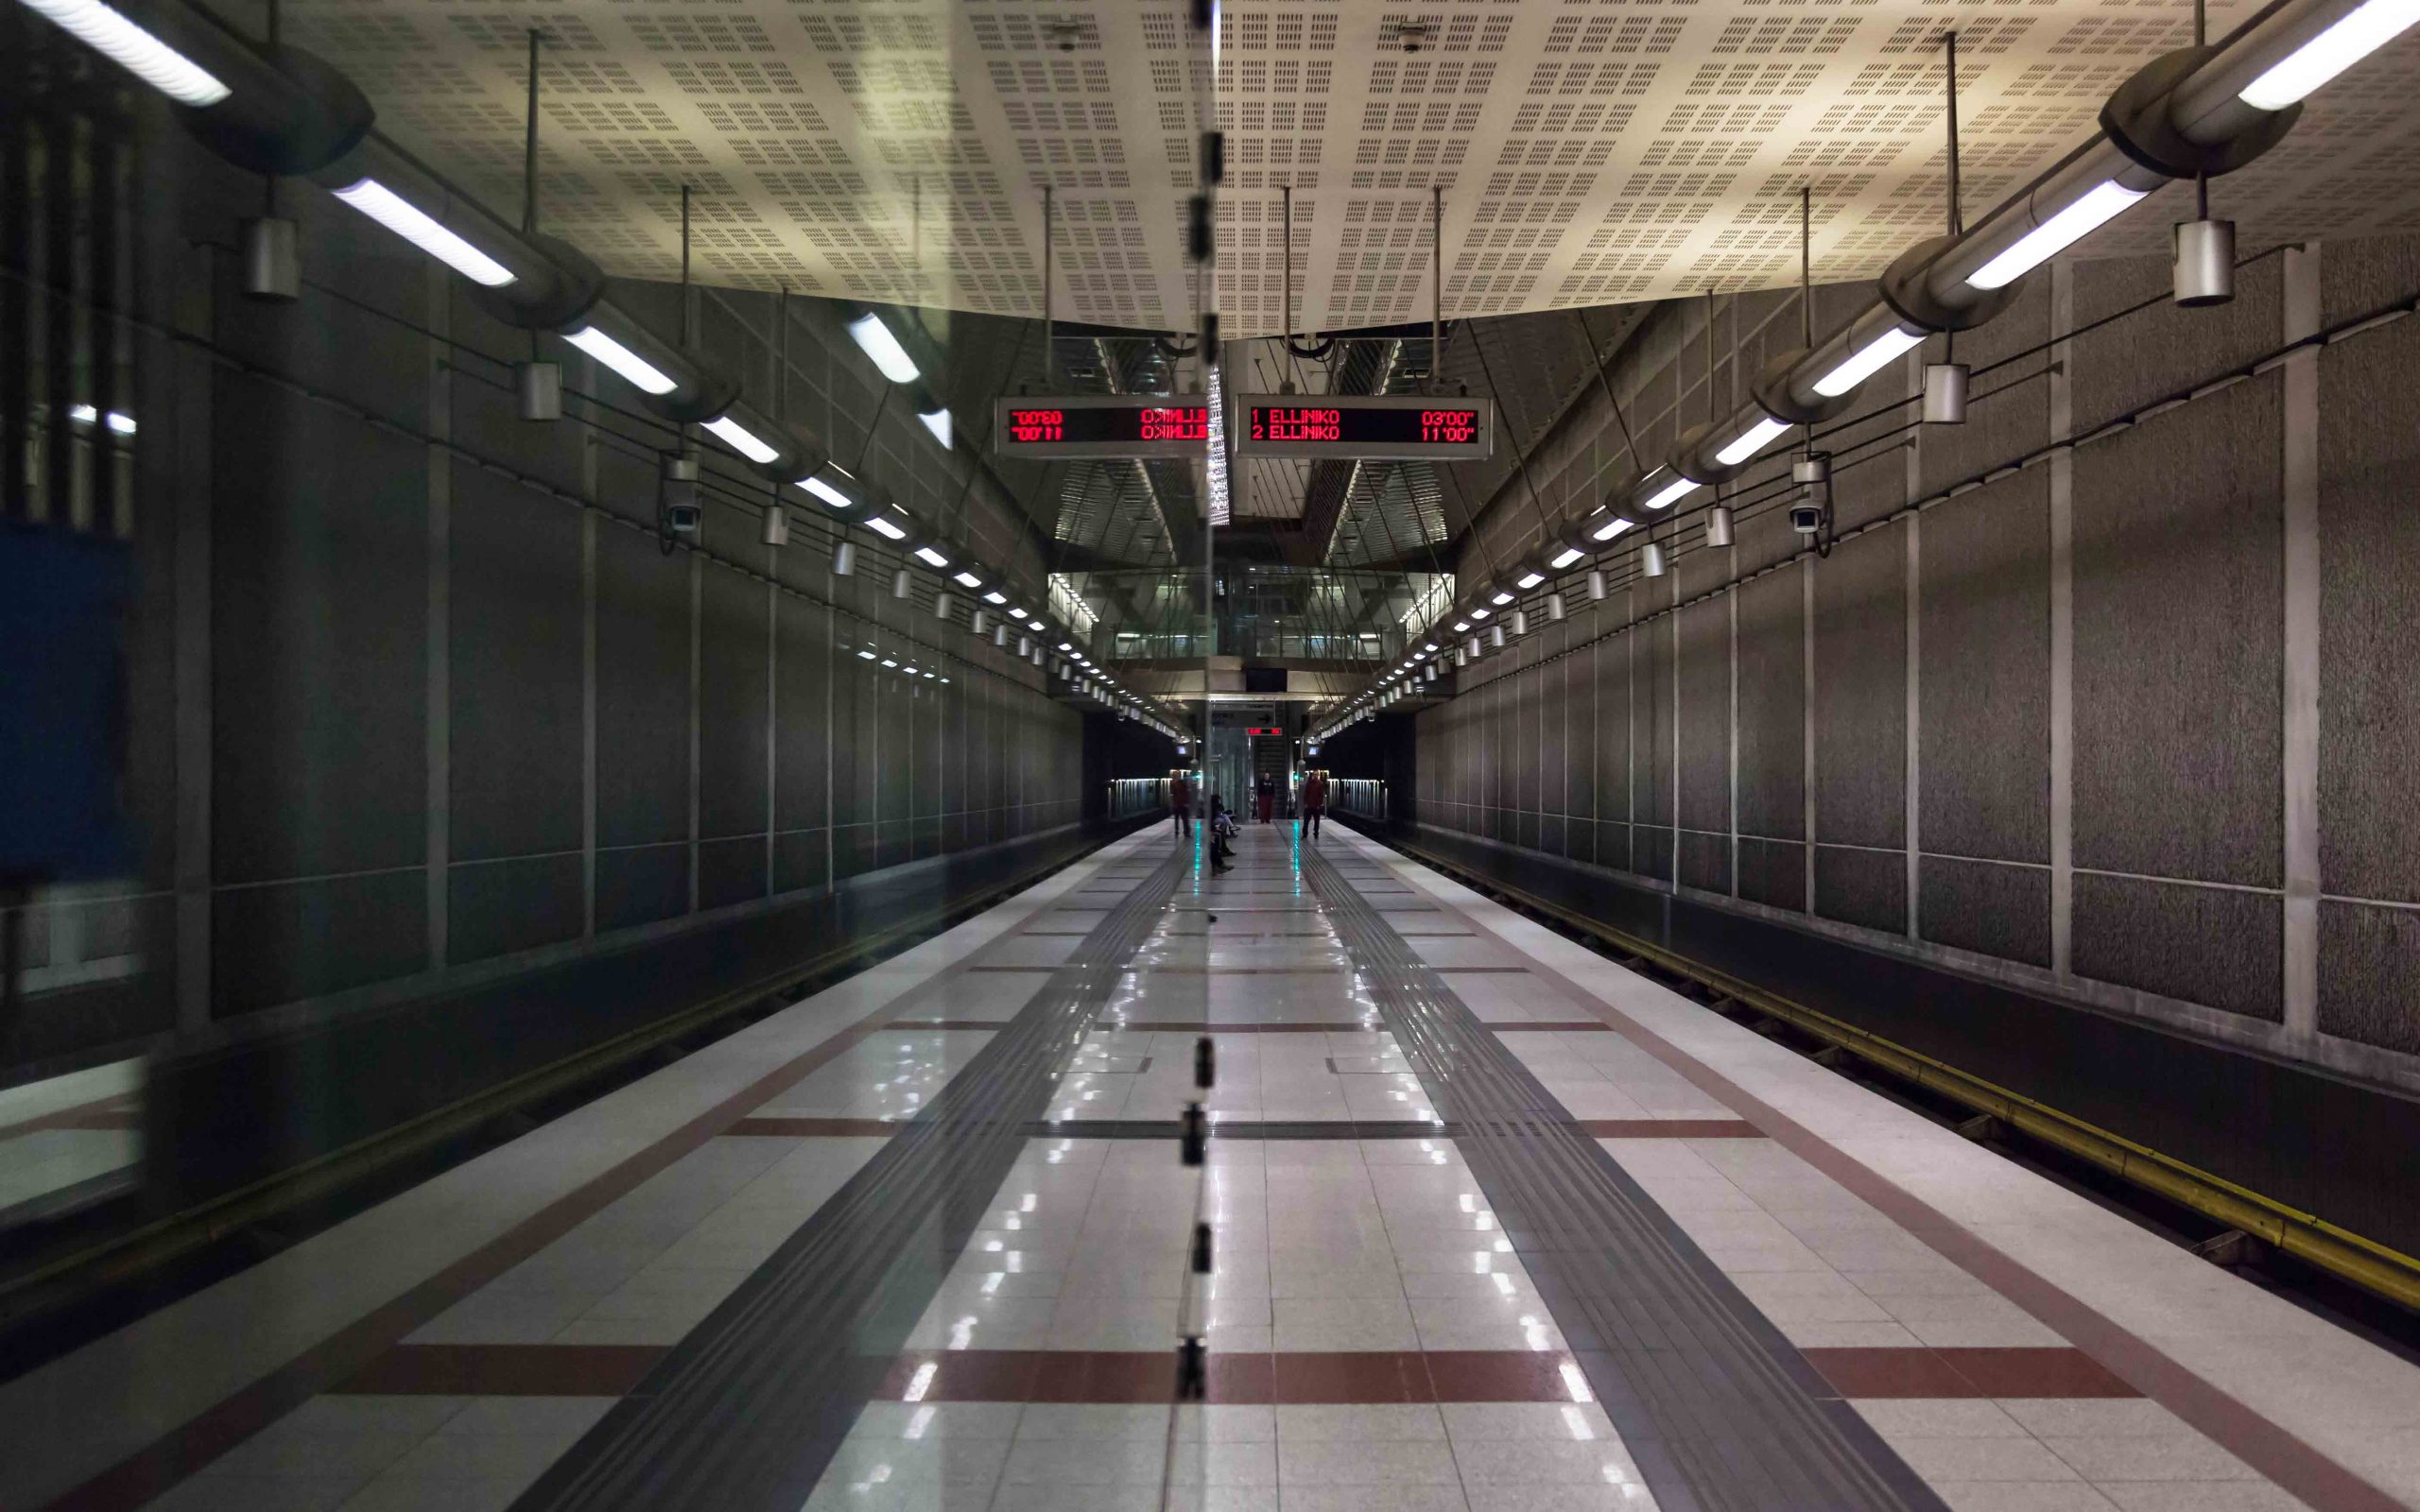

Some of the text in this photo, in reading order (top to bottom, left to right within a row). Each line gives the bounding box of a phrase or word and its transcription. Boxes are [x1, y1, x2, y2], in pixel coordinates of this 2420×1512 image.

[1252, 409, 1475, 425] 1 ELLINIKO 03'00"
[1252, 424, 1475, 441] 2 ELLINIKO 11'00"
